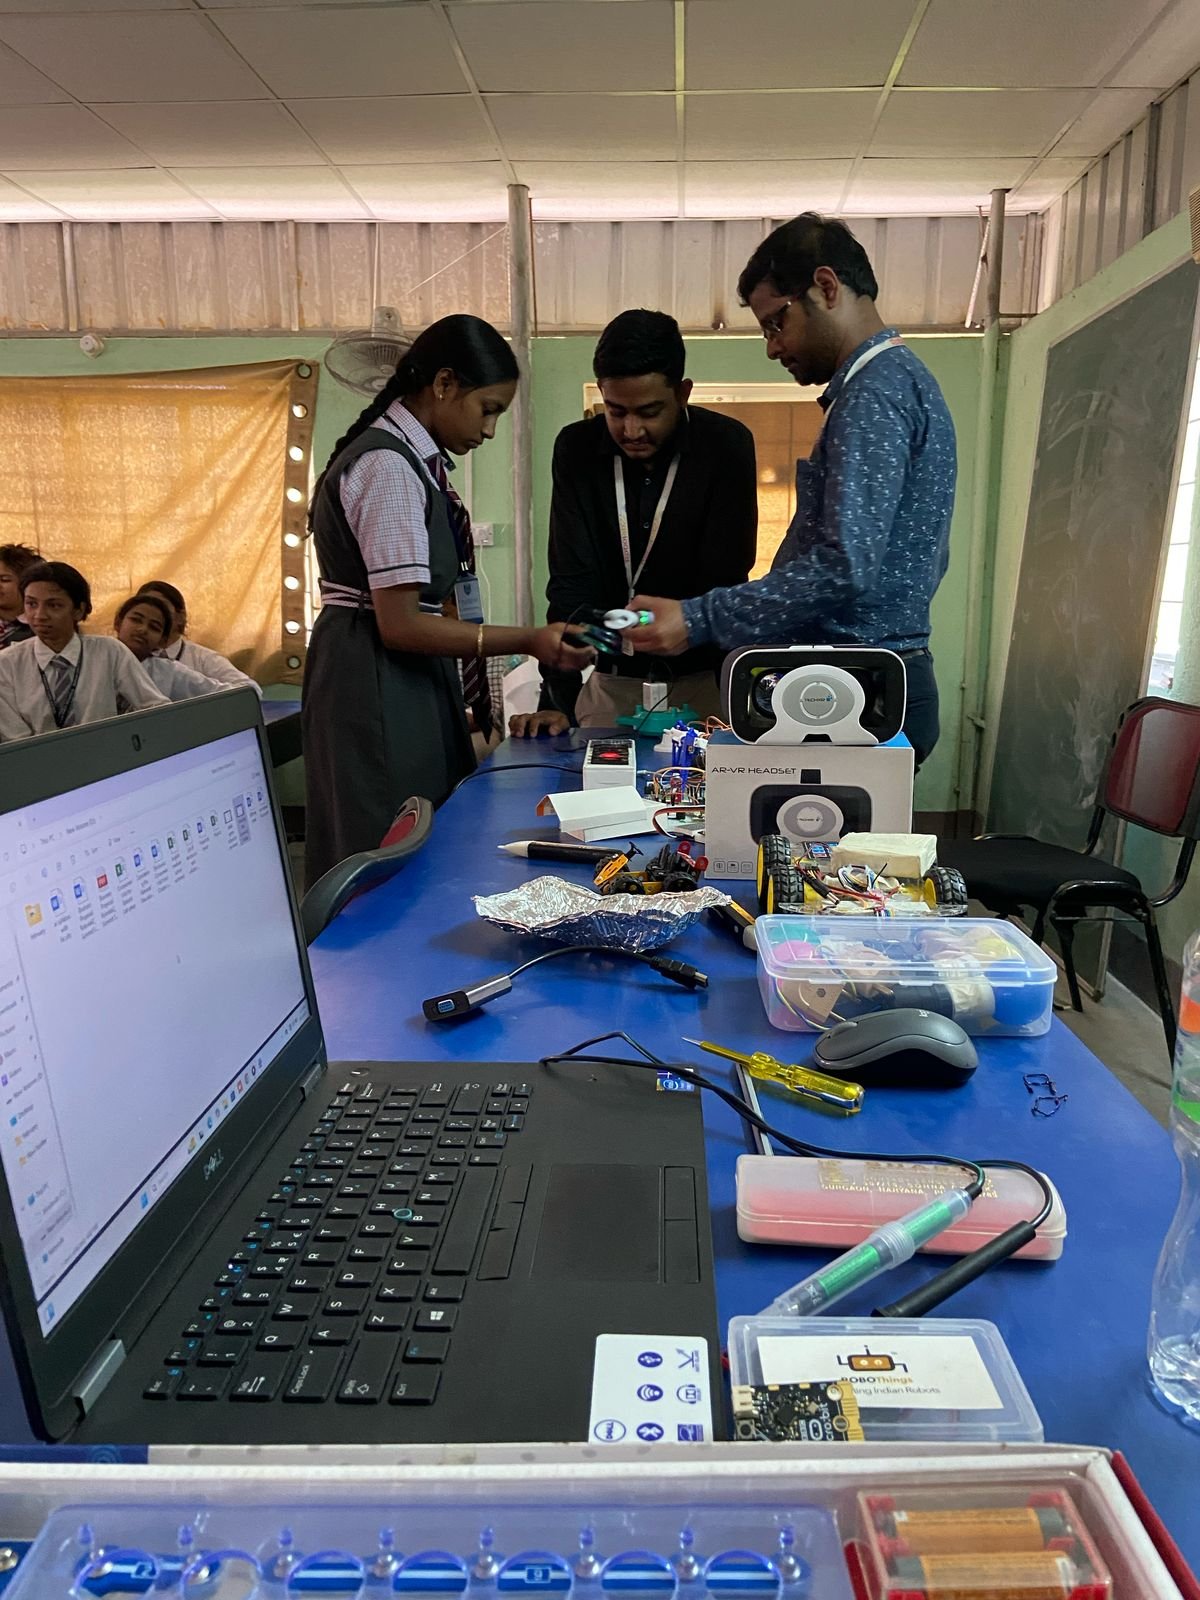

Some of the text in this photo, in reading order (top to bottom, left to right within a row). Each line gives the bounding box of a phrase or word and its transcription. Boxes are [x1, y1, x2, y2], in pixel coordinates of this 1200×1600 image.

[748, 767, 797, 775] HEADSET
[383, 1287, 395, 1295] X
[278, 1303, 293, 1314] W
[372, 1315, 384, 1323] Z
[317, 1329, 330, 1338] A
[264, 1335, 278, 1343] Q
[873, 1385, 904, 1394] Indian
[905, 1385, 941, 1394] Robots
[819, 1402, 835, 1441] cro:bit
